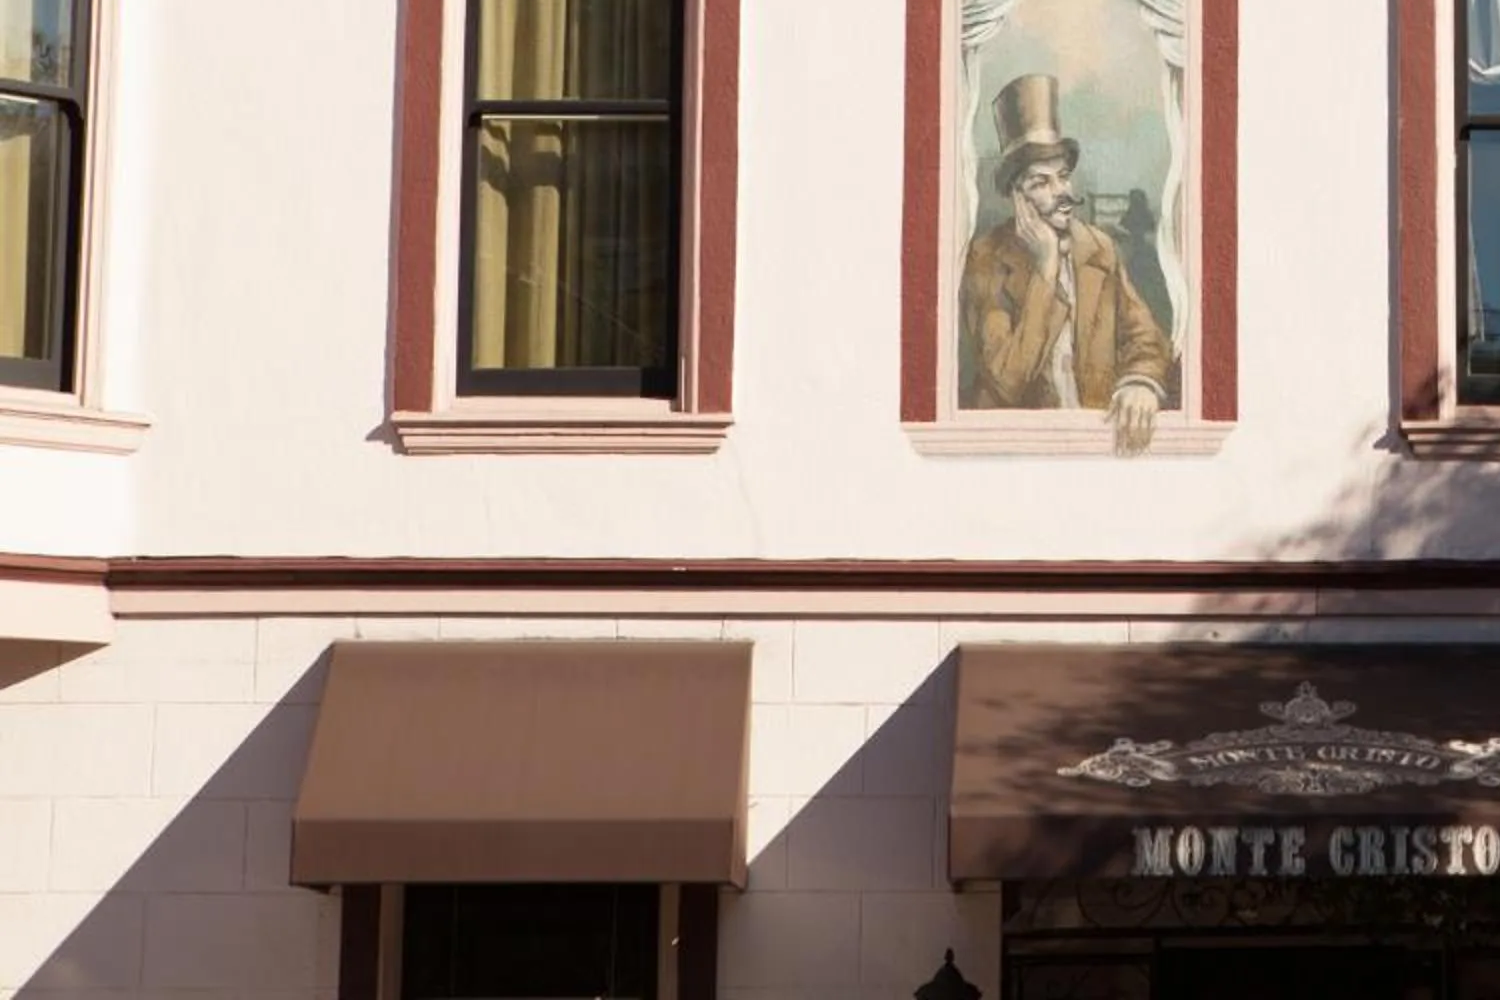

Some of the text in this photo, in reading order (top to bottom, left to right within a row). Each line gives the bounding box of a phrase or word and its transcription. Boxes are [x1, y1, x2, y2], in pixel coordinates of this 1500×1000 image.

[1189, 745, 1441, 770] MONTE CRISTO
[1132, 826, 1306, 876] MONTE
